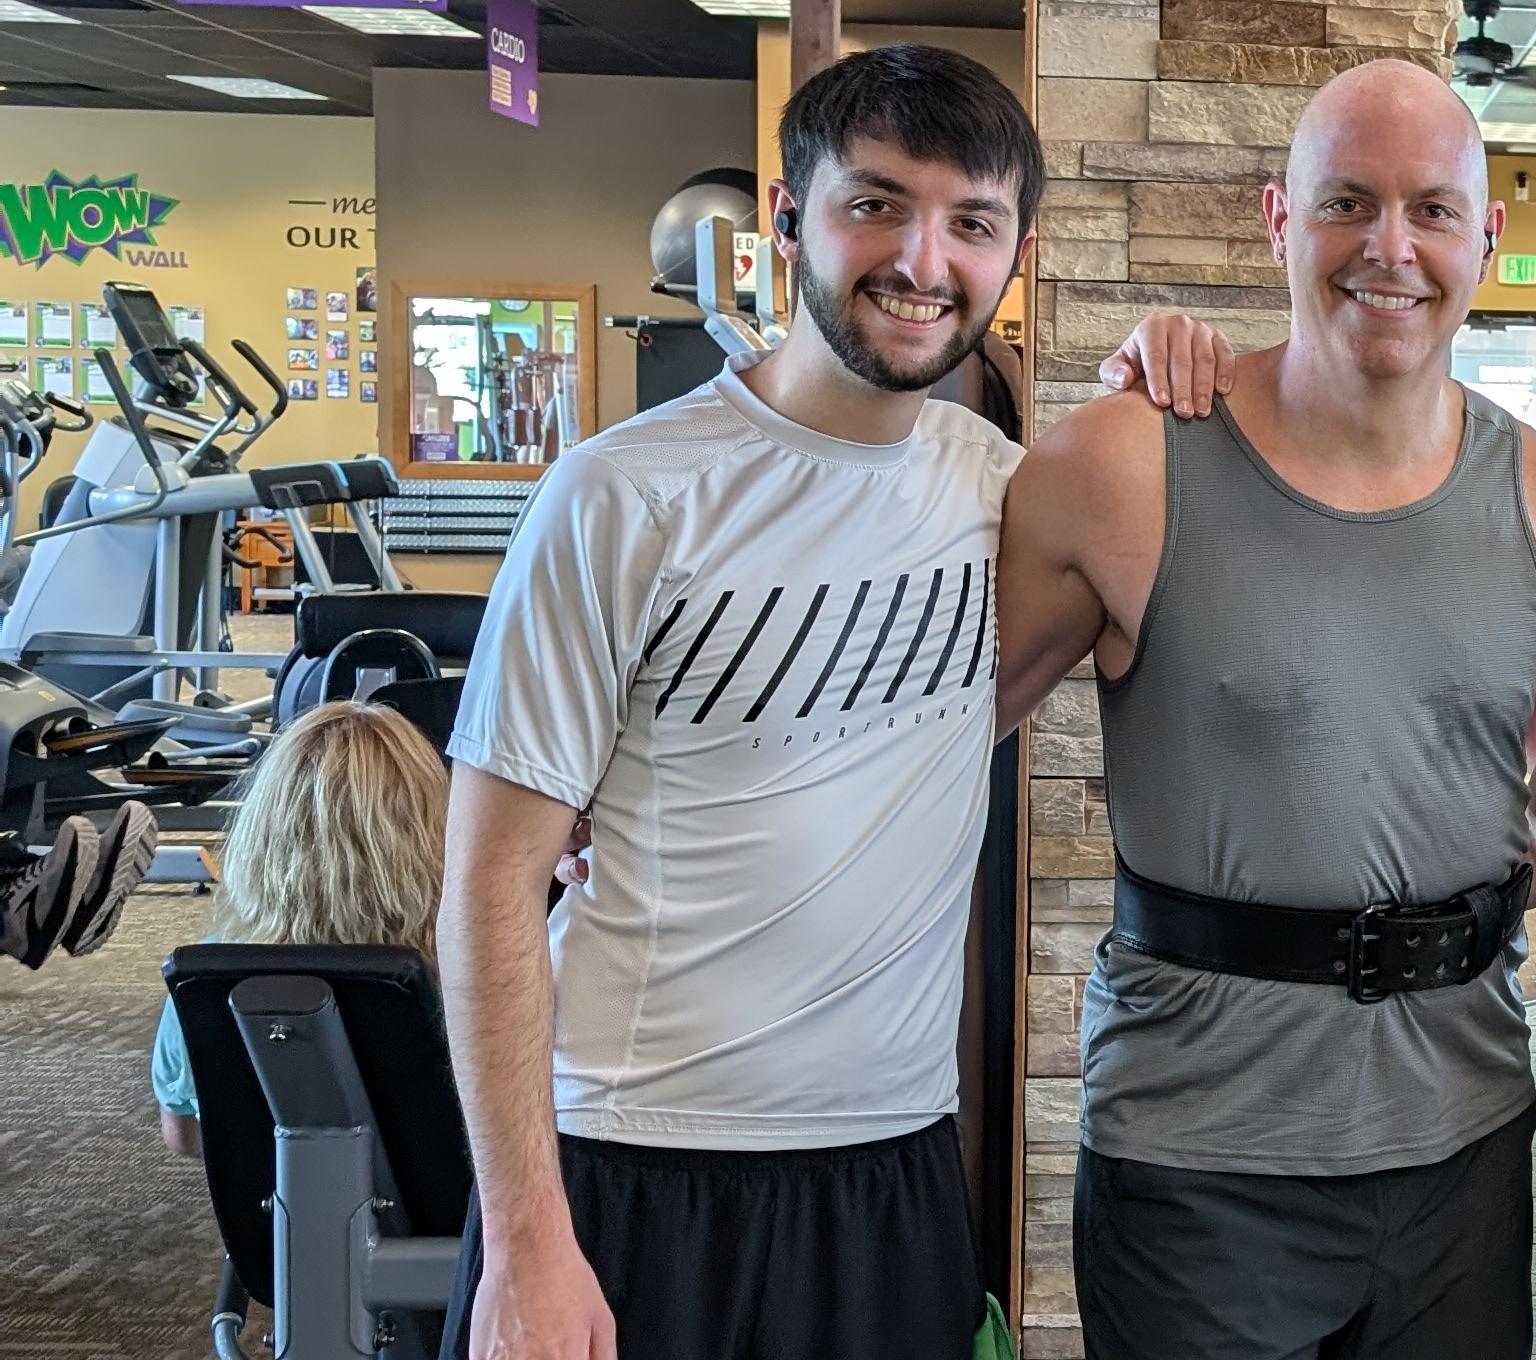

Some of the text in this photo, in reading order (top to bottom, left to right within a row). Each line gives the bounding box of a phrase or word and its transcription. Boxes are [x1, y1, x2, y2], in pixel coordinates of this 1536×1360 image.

[491, 27, 525, 64] CARDIO
[0, 184, 150, 264] WOW
[286, 226, 361, 250] OUR
[126, 250, 188, 268] WALL
